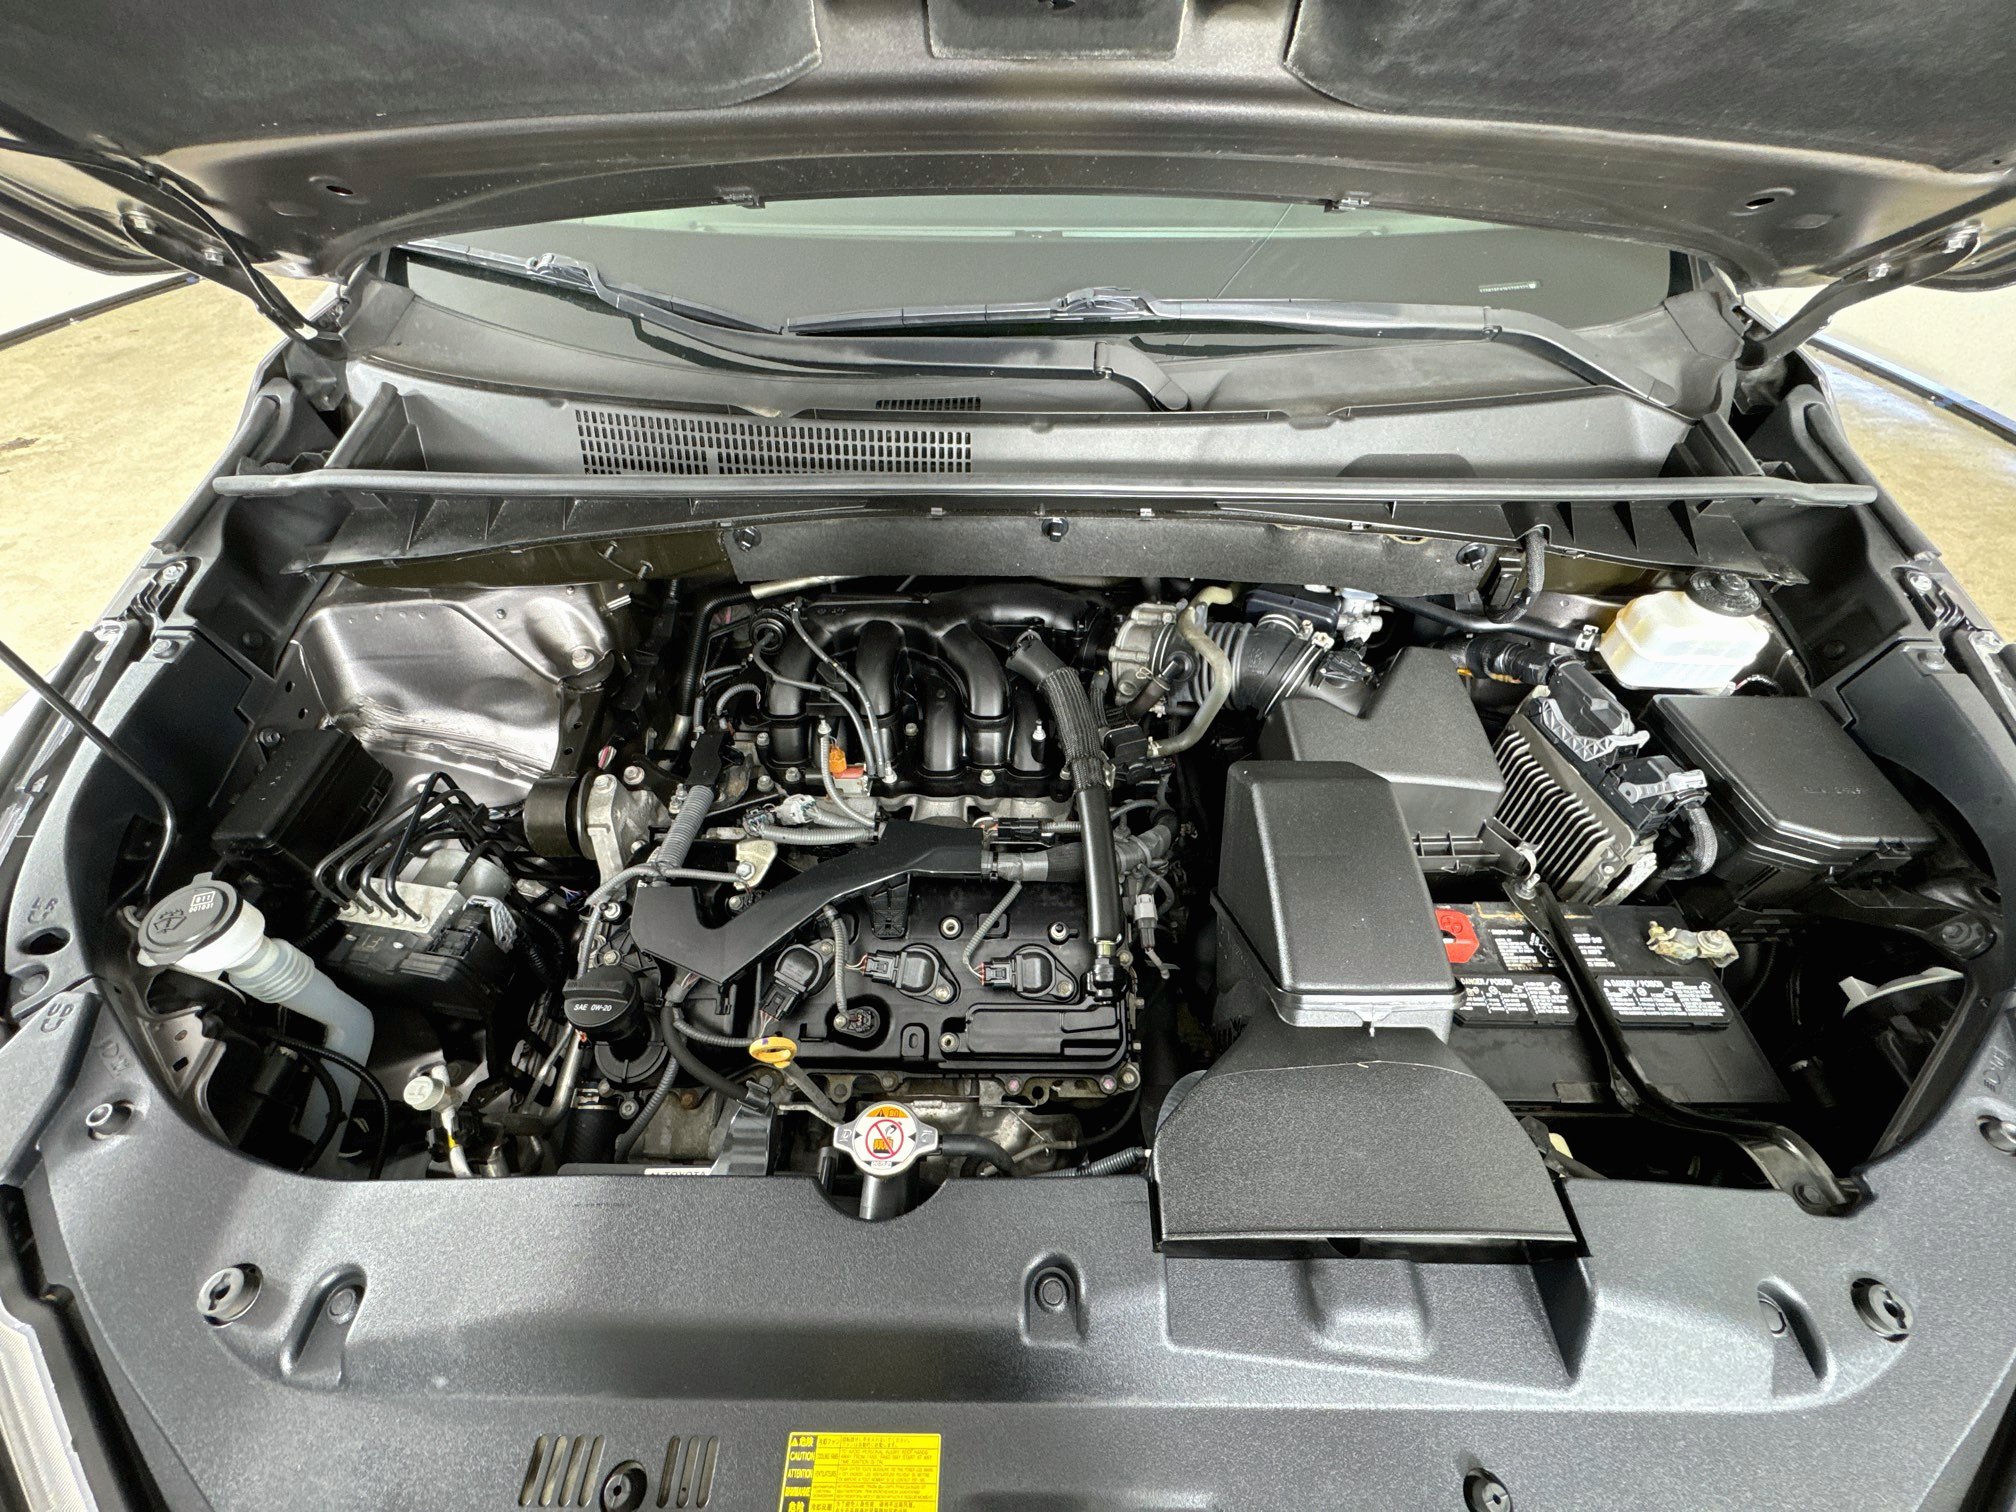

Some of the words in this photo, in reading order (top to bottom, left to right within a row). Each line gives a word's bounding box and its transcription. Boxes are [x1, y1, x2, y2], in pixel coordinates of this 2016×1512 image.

[573, 1003, 588, 1011] SAE
[590, 1003, 613, 1012] 0W-20
[790, 1451, 816, 1461] CAUTION
[787, 1468, 813, 1479] ATTENTION
